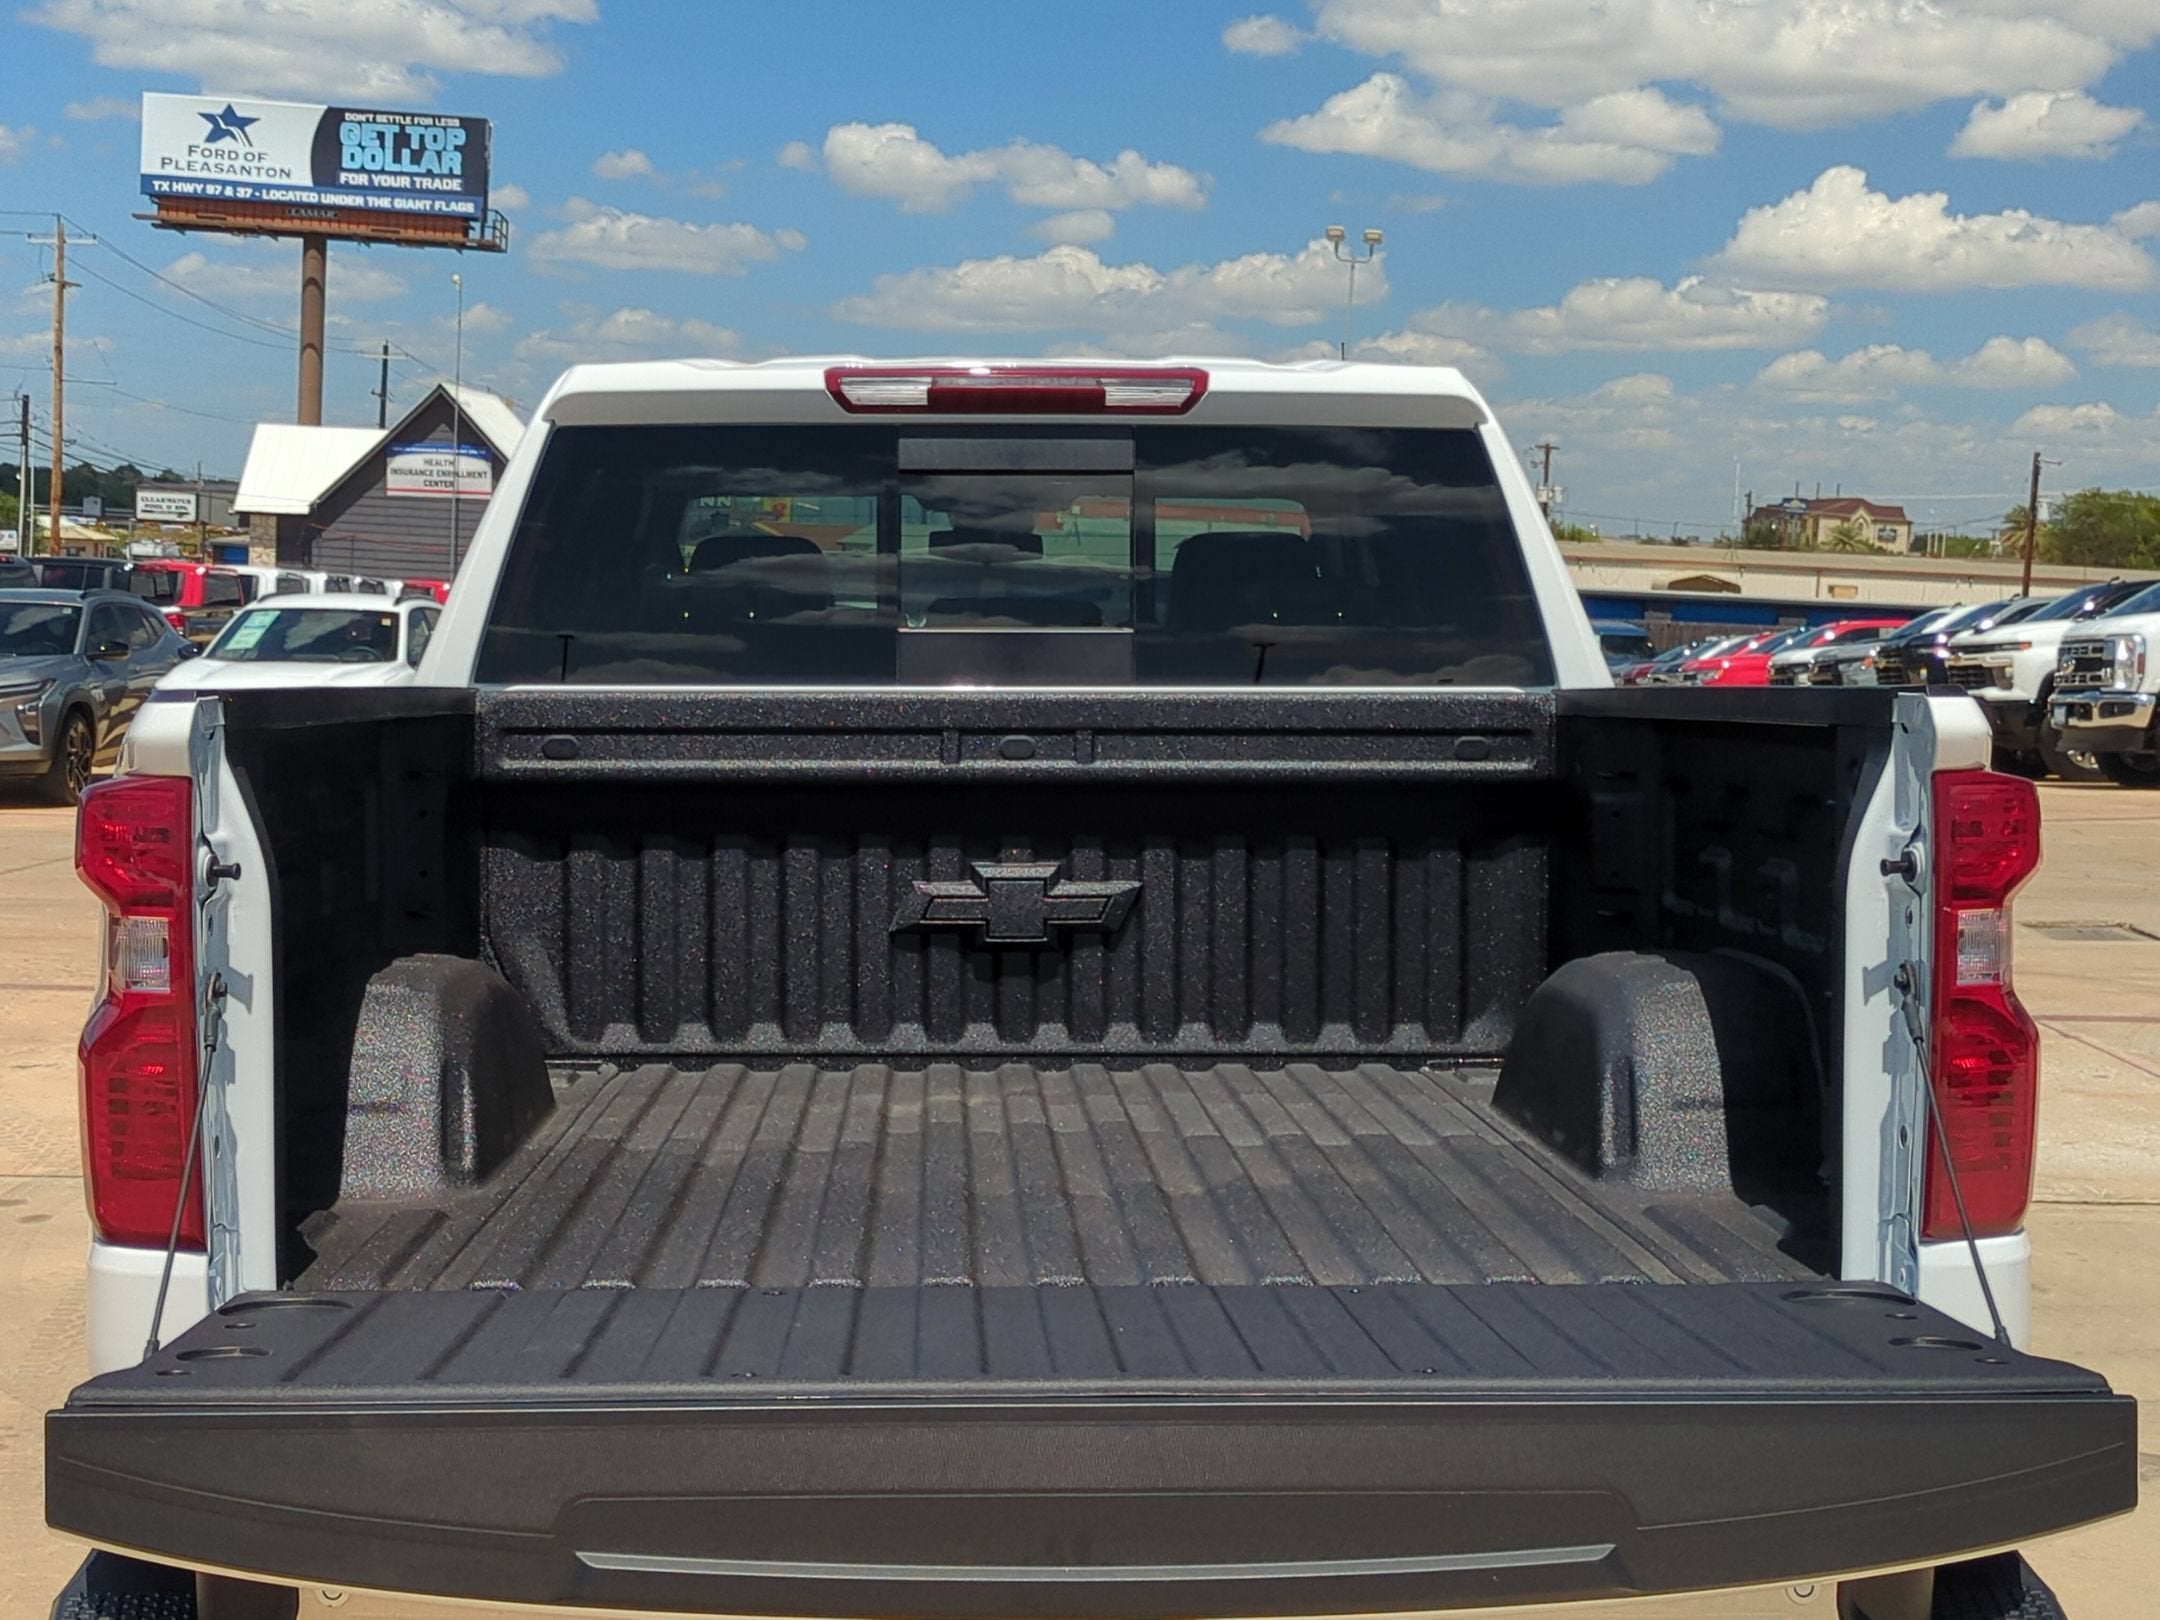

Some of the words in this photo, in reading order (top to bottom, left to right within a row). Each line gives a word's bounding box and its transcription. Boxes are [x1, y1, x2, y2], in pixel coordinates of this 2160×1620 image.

[344, 112, 375, 122] DON'T
[375, 114, 412, 125] SETTLE
[414, 116, 433, 126] FOR
[435, 117, 460, 127] LESS
[339, 121, 400, 148] GET
[405, 126, 466, 151] TOP
[188, 144, 239, 161] FORD
[243, 151, 270, 164] OF
[341, 144, 463, 176] DOLLAR
[160, 156, 292, 180] PLEASANTON
[339, 172, 369, 187] FOR
[371, 174, 411, 189] YOUR
[413, 177, 463, 192] TRADE
[152, 180, 170, 192] TX
[172, 182, 204, 195] HWY
[205, 184, 221, 196] 97
[224, 186, 234, 197] &
[235, 186, 254, 198] 37
[261, 189, 319, 203] LOCATED
[320, 193, 365, 207] UNDER
[366, 196, 392, 209] THE
[393, 198, 433, 211] GIANT
[434, 201, 475, 214] FLAGS
[423, 458, 455, 466] HEALTH
[390, 468, 434, 477] INSURANCE
[423, 479, 455, 488] CENTER
